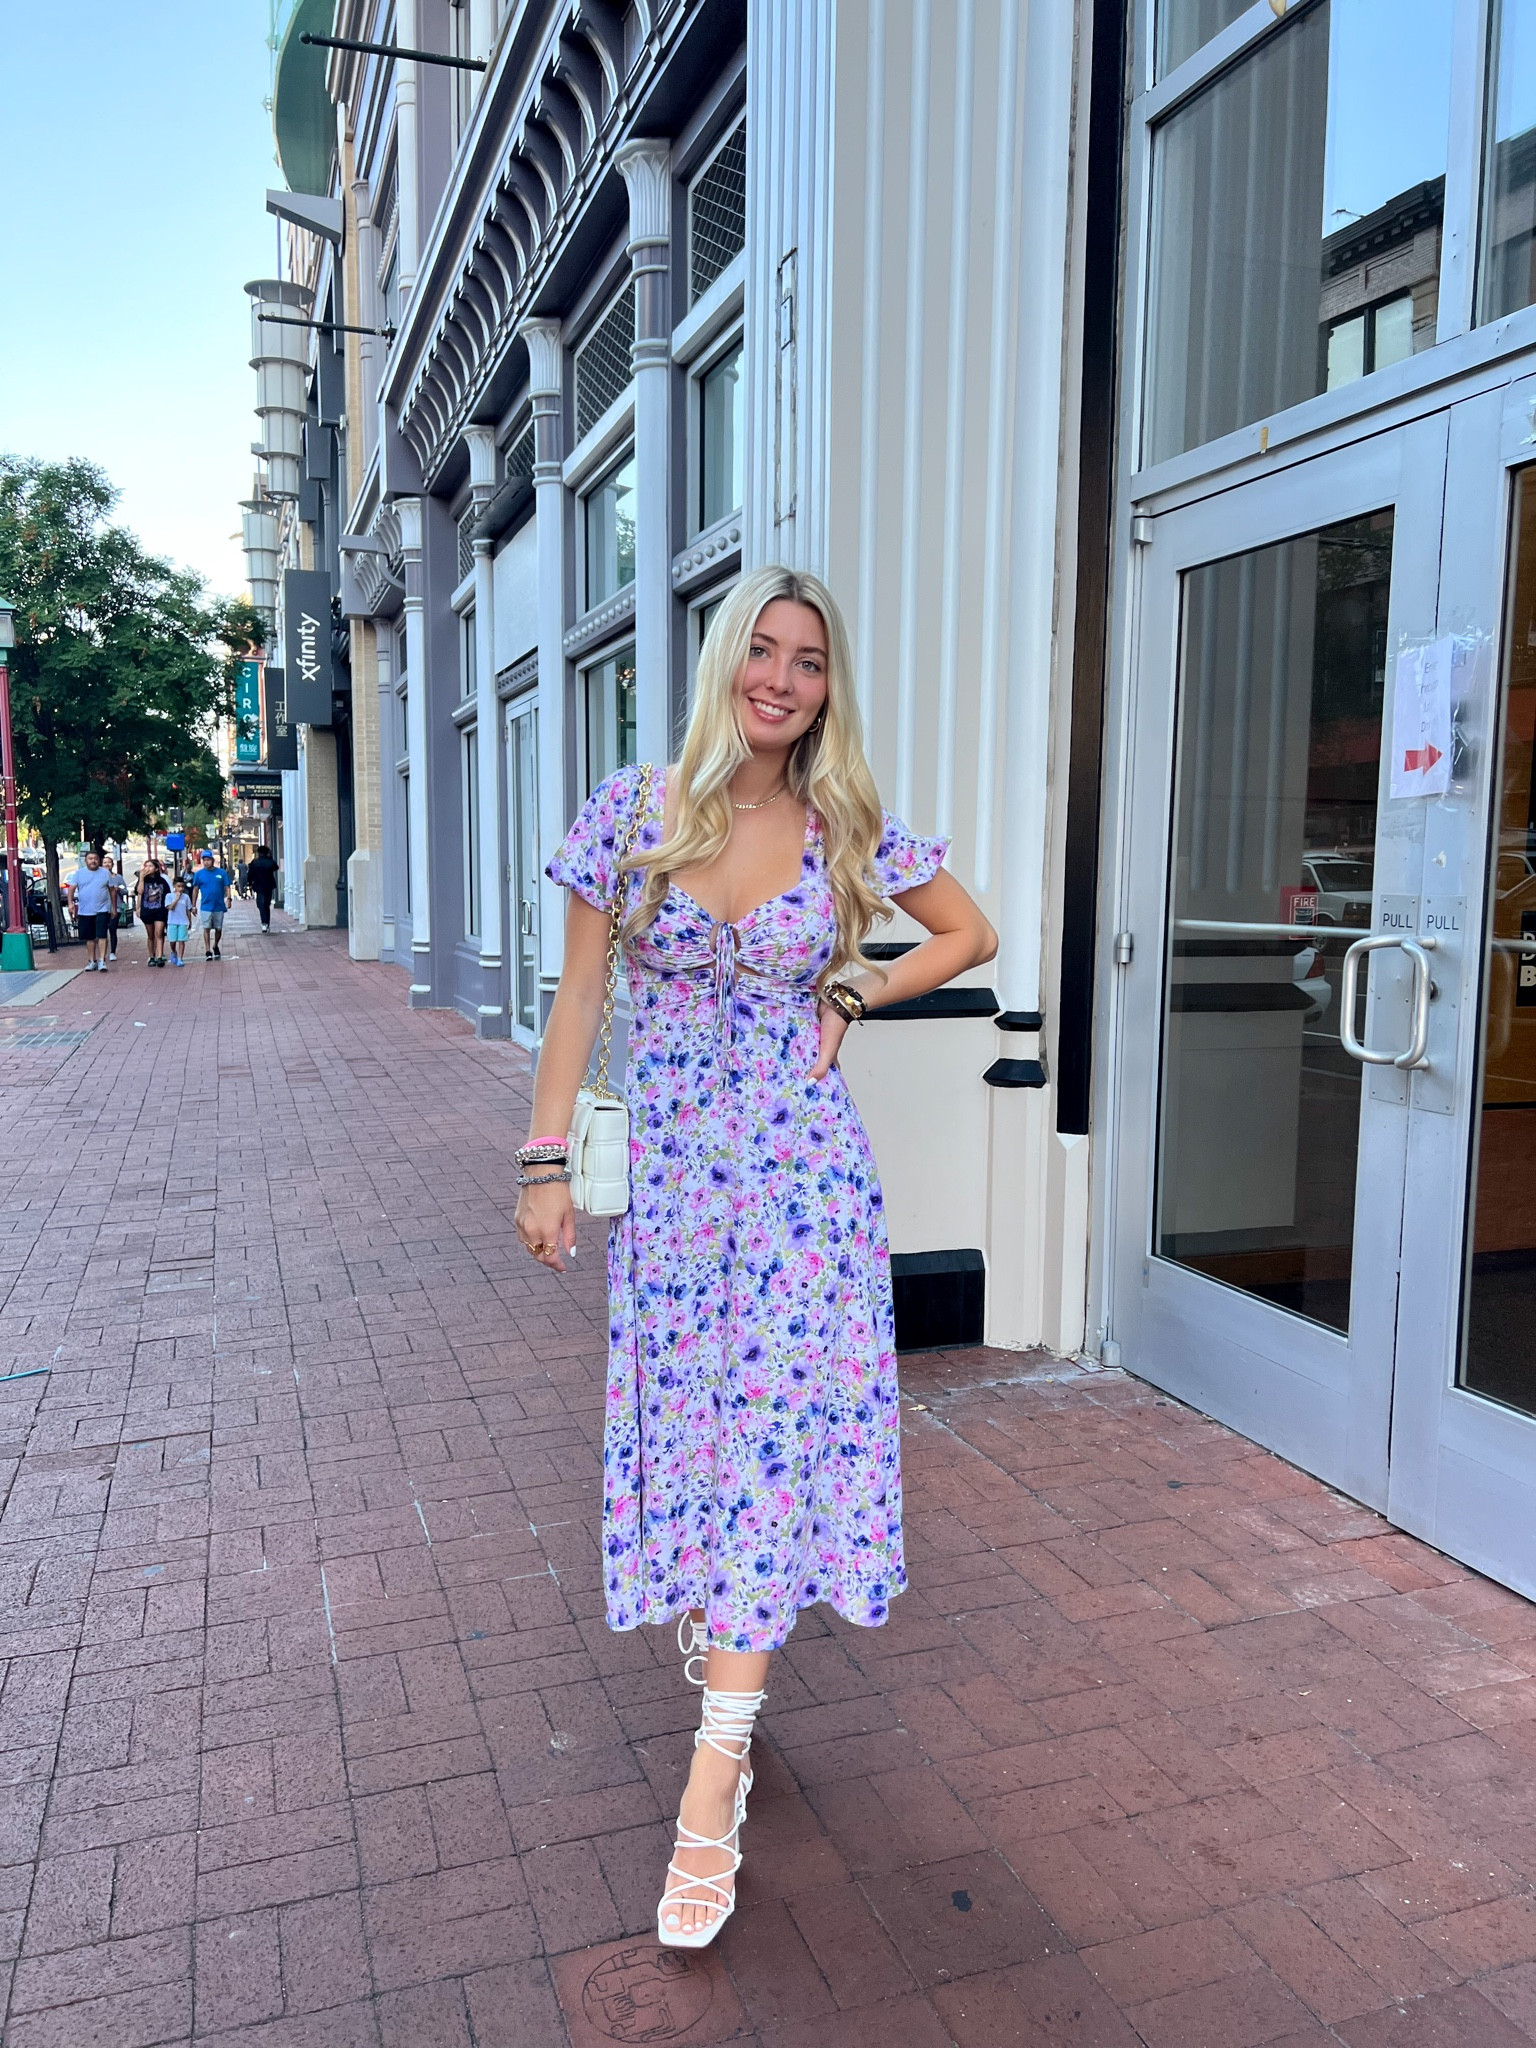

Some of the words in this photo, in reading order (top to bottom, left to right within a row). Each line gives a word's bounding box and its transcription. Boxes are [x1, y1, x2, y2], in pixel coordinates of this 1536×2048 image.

[296, 612, 321, 681] xfinity
[1293, 897, 1315, 907] FIRE
[1382, 913, 1413, 929] PULL
[1427, 914, 1459, 930] PULL
